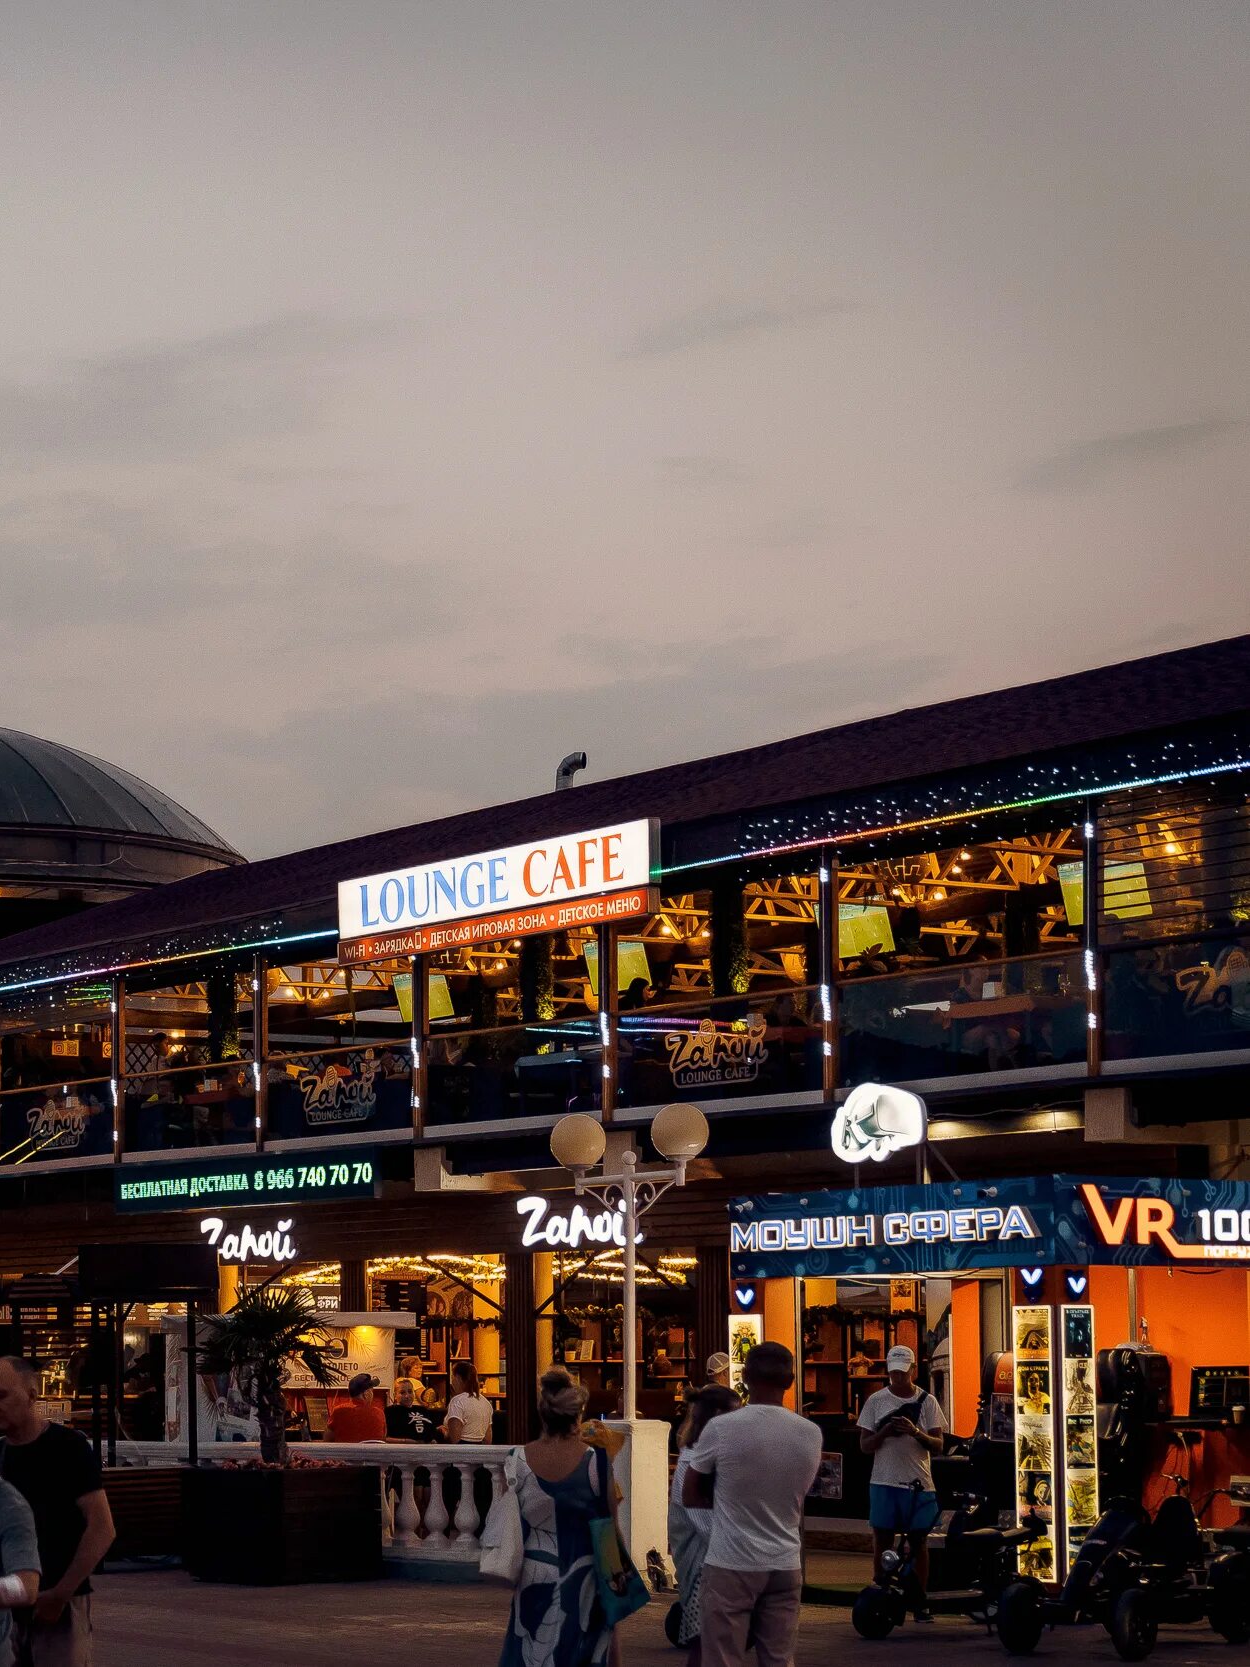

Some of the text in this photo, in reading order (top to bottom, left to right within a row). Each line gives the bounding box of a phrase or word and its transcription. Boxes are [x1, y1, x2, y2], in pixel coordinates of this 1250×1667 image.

[360, 833, 625, 928] LOUNGE CAFE
[344, 895, 642, 960] WI-FI ЗАРЯДКА ДЕТСКАЯ ИГРОВАЯ ЗОНА ДЕТСКОЕ МЕНЮ
[681, 1065, 751, 1084] LOUNGE CAFE
[310, 1109, 342, 1121] LOUNGE
[121, 1162, 372, 1199] БЕСПЛАТНАЯ ДОСТАВКА 8 966 740 70 70
[730, 1205, 1037, 1252] МОУШН СФЕРА
